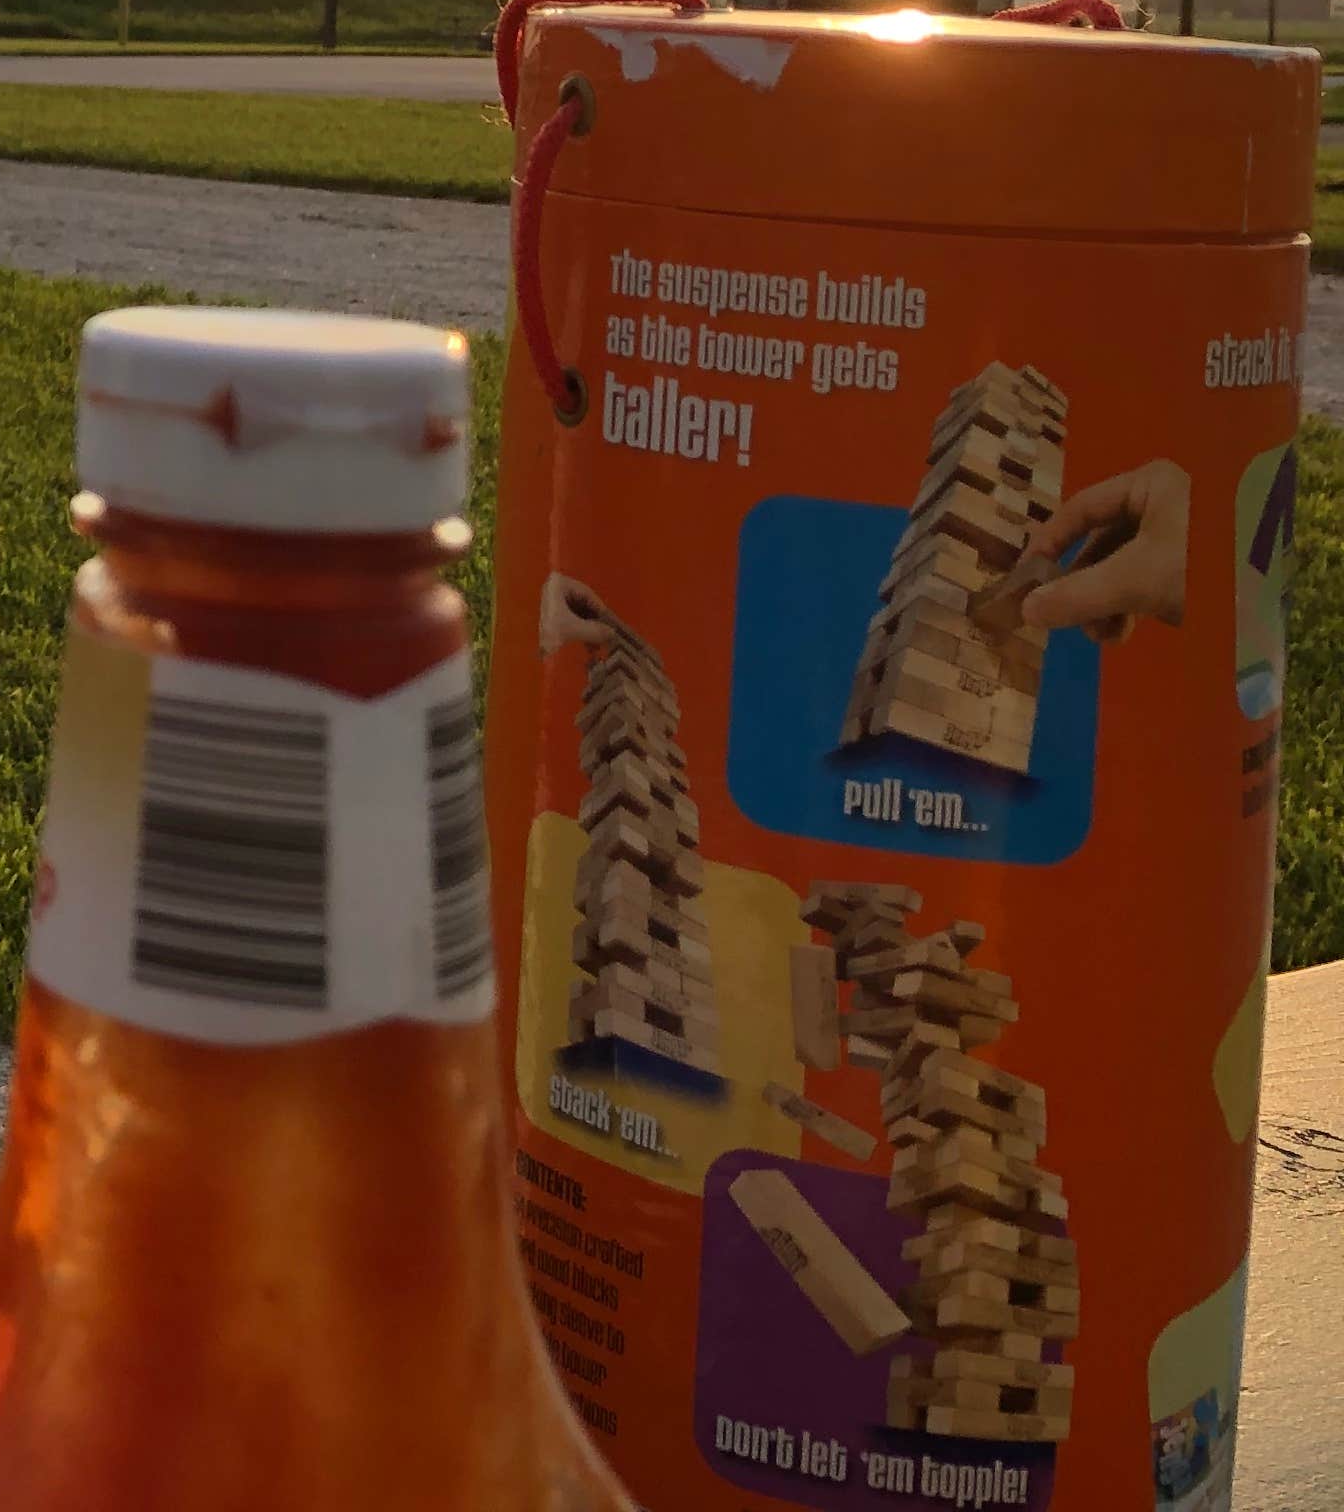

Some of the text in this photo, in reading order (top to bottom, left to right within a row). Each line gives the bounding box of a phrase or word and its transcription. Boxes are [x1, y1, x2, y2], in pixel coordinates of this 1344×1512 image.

[609, 248, 927, 329] The suspense builds
[606, 313, 899, 395] as the tower gets
[602, 370, 754, 467] taller!
[572, 1260, 619, 1313] blocks
[584, 1231, 645, 1280] crafted
[558, 1302, 604, 1346] sleeve
[606, 1324, 625, 1356] to
[800, 1430, 848, 1483] let
[860, 1448, 915, 1494] 'em
[920, 1455, 1029, 1510] topple!
